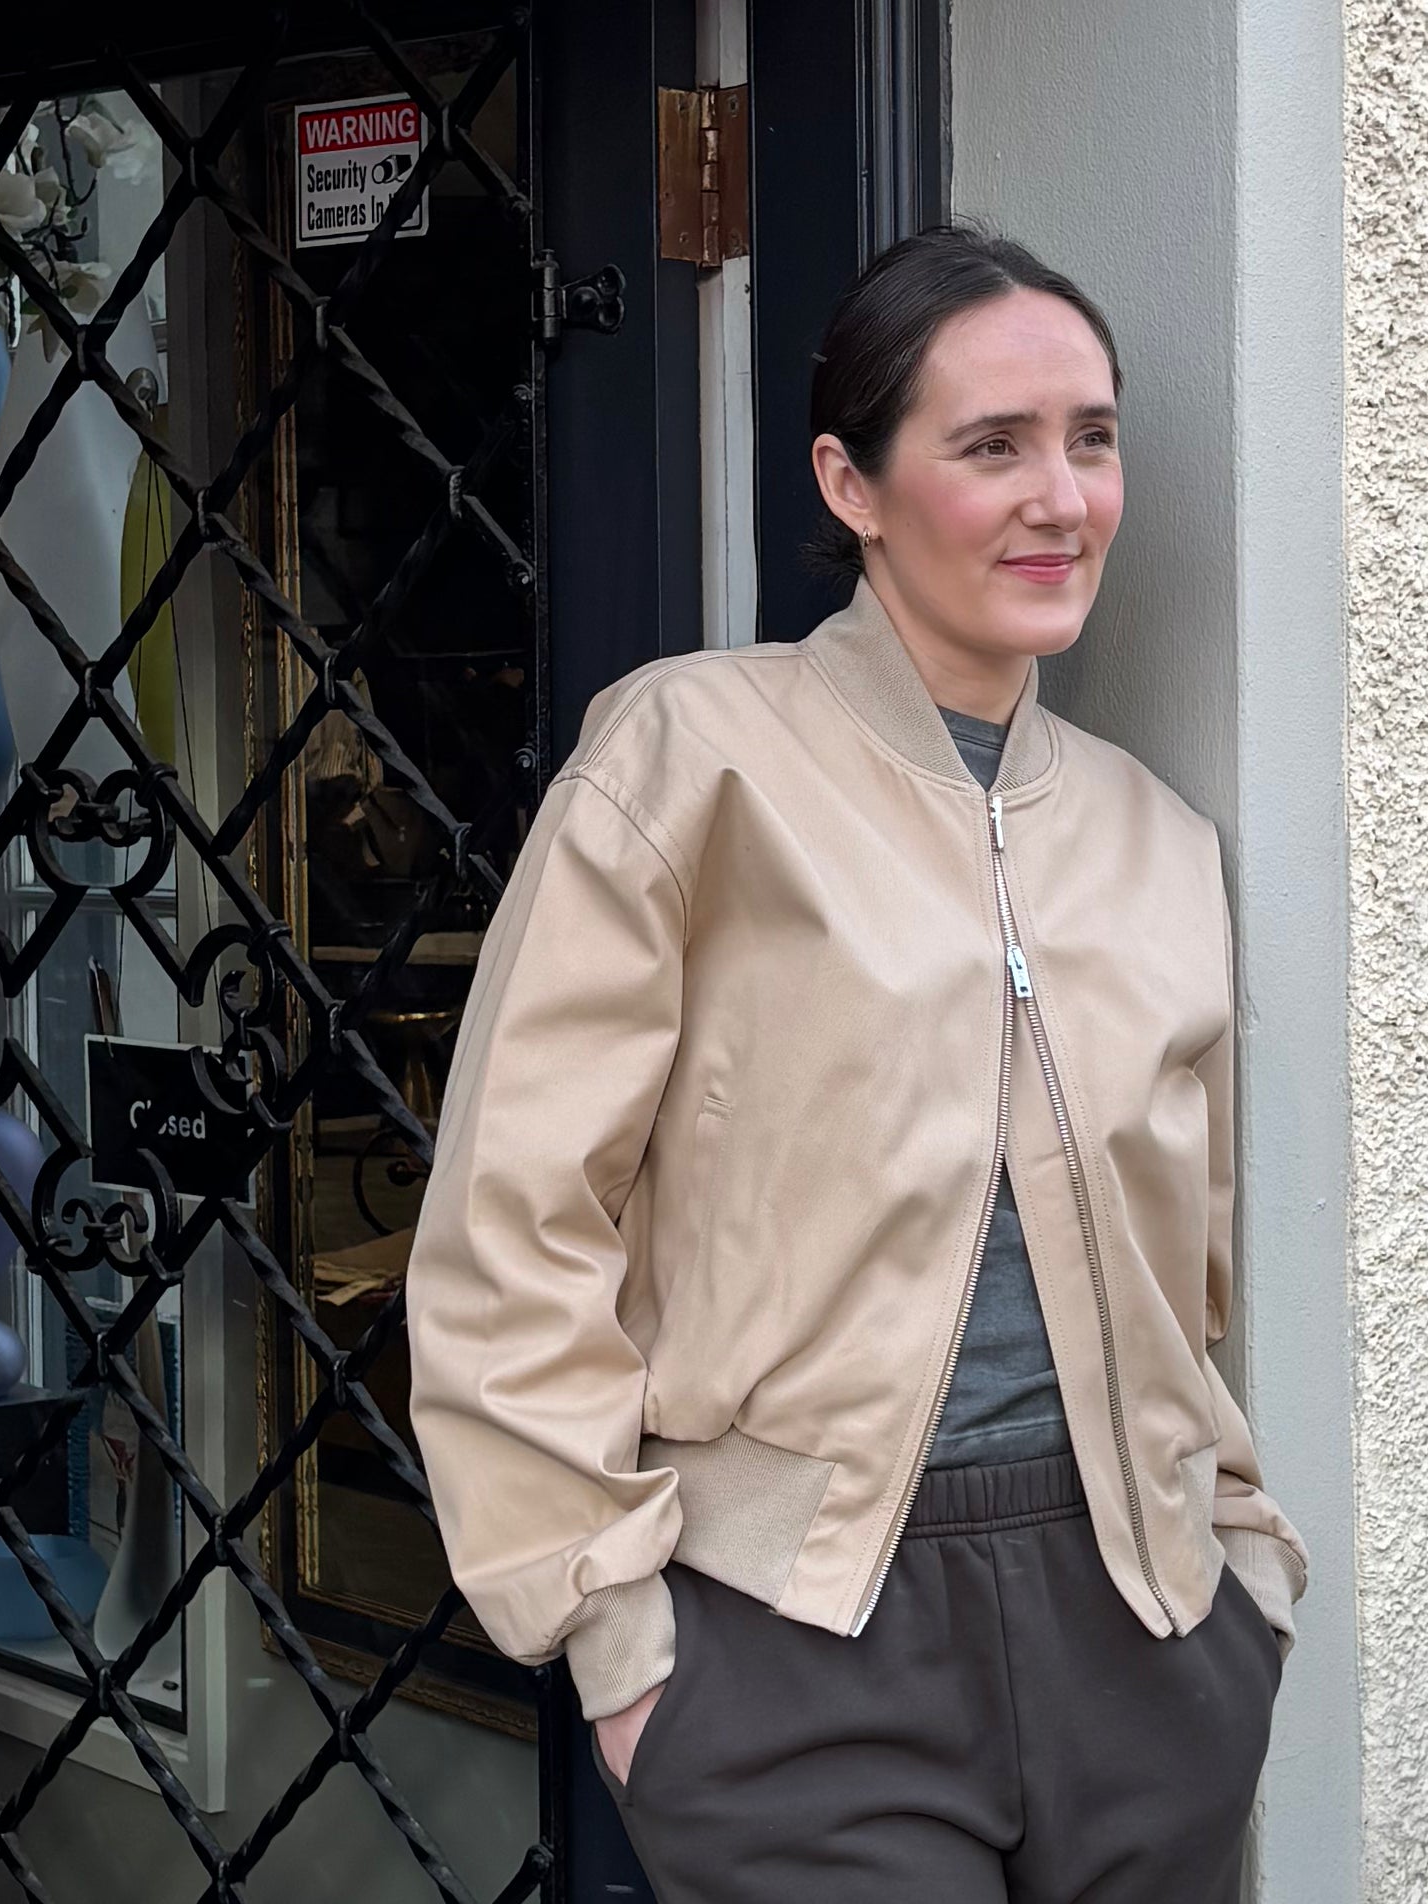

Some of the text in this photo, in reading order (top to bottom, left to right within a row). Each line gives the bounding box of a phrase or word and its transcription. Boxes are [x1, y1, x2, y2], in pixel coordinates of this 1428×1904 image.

[305, 107, 416, 150] WARNING
[307, 159, 367, 194] Security
[307, 195, 384, 231] Cameras In
[130, 1100, 206, 1140] Csed
